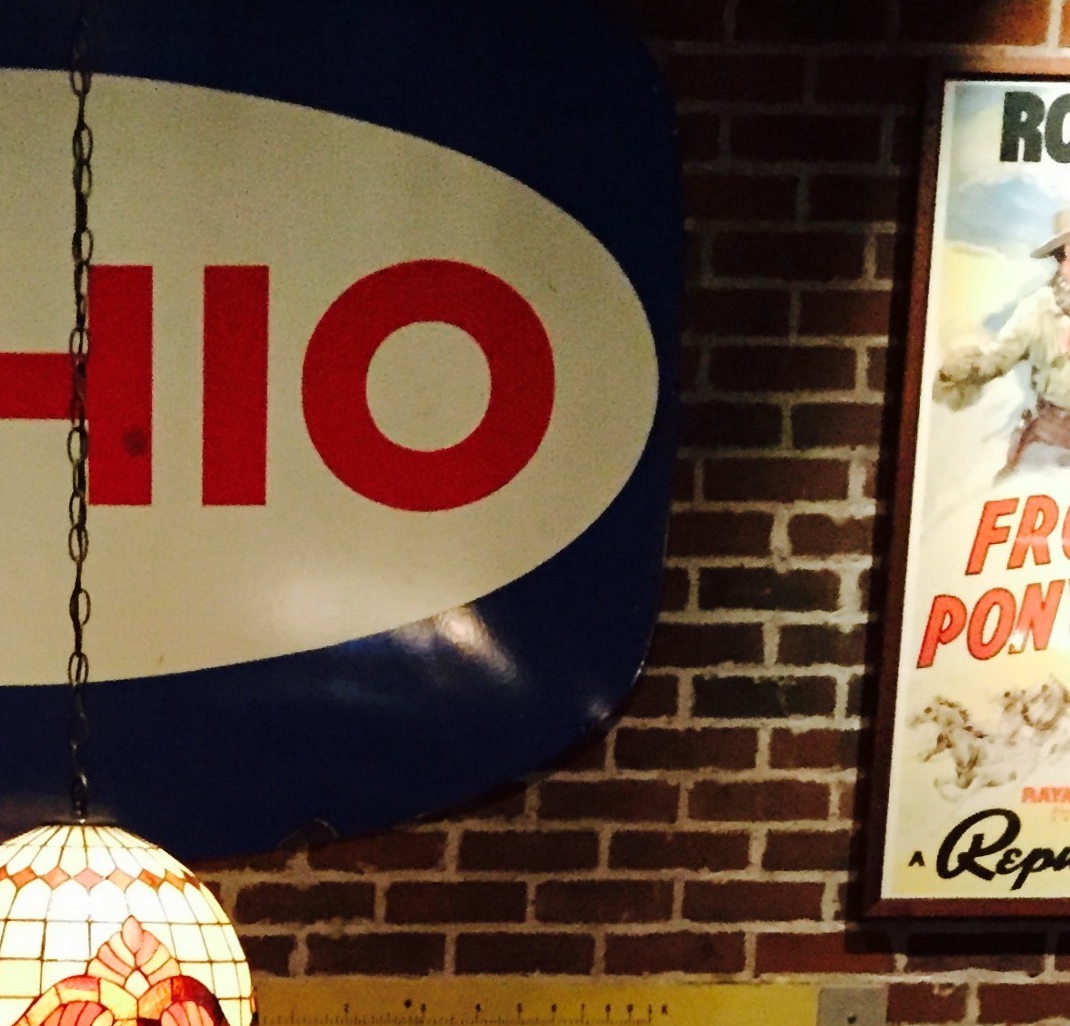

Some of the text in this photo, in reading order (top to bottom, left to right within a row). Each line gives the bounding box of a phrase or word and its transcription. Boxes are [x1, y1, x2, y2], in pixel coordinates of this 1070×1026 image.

[965, 494, 1070, 575] FR
[916, 579, 1070, 669] PON
[908, 851, 925, 867] A
